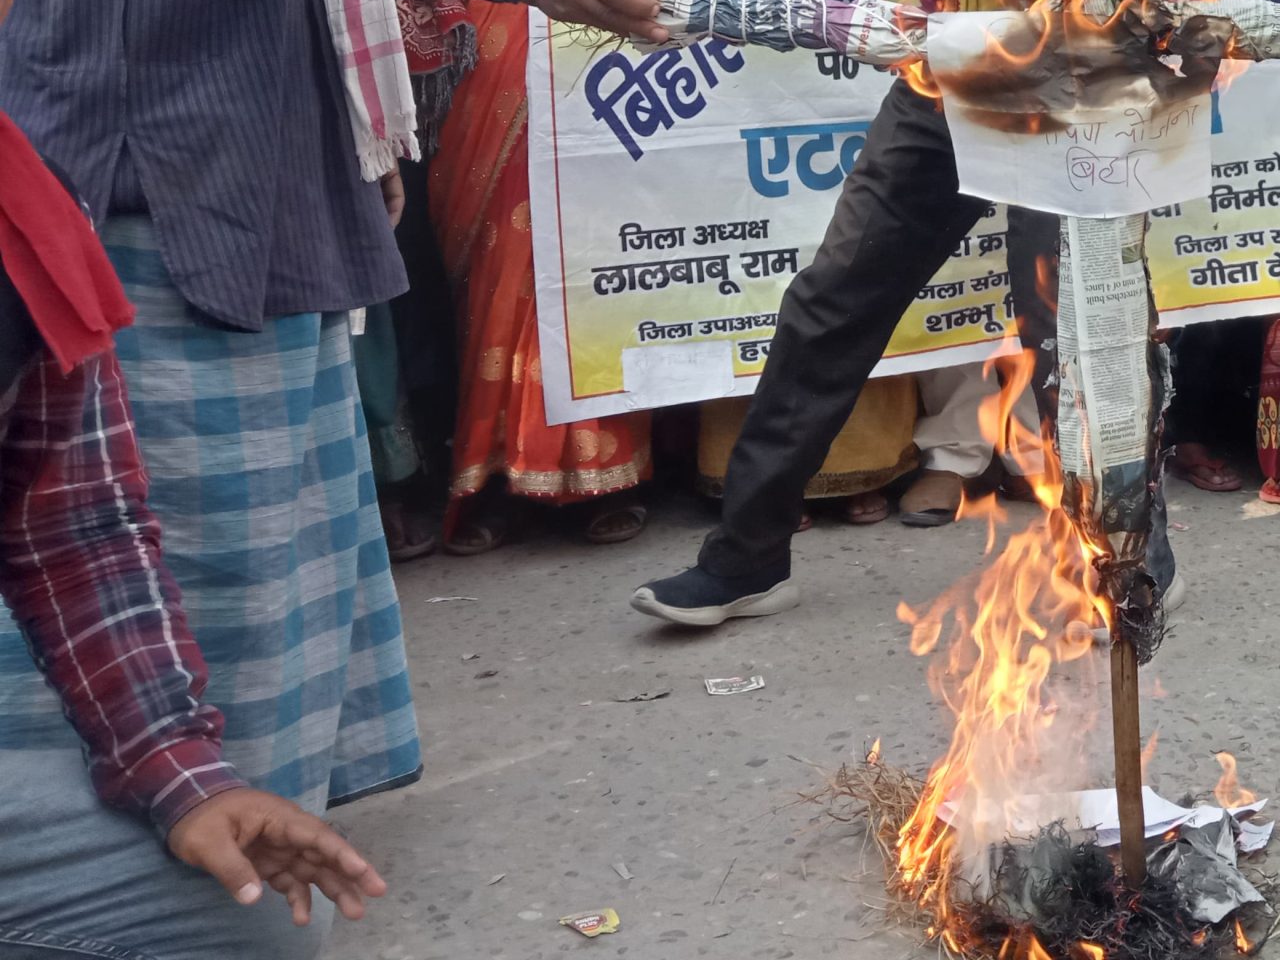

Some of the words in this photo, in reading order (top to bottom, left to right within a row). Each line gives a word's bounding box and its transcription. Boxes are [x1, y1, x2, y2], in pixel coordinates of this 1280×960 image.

[619, 222, 686, 252] जिला
[693, 219, 770, 246] अध्यक्ष
[1174, 234, 1228, 256] जिला
[1235, 231, 1265, 248] उप
[591, 254, 741, 296] लालबाबू
[740, 248, 799, 278] राम
[1191, 258, 1258, 287] गीता
[1085, 283, 1105, 293] lanes
[1086, 296, 1106, 306] built
[638, 321, 693, 342] जिला
[698, 313, 778, 335] उपाअध्य
[926, 303, 1004, 333] शम्भू
